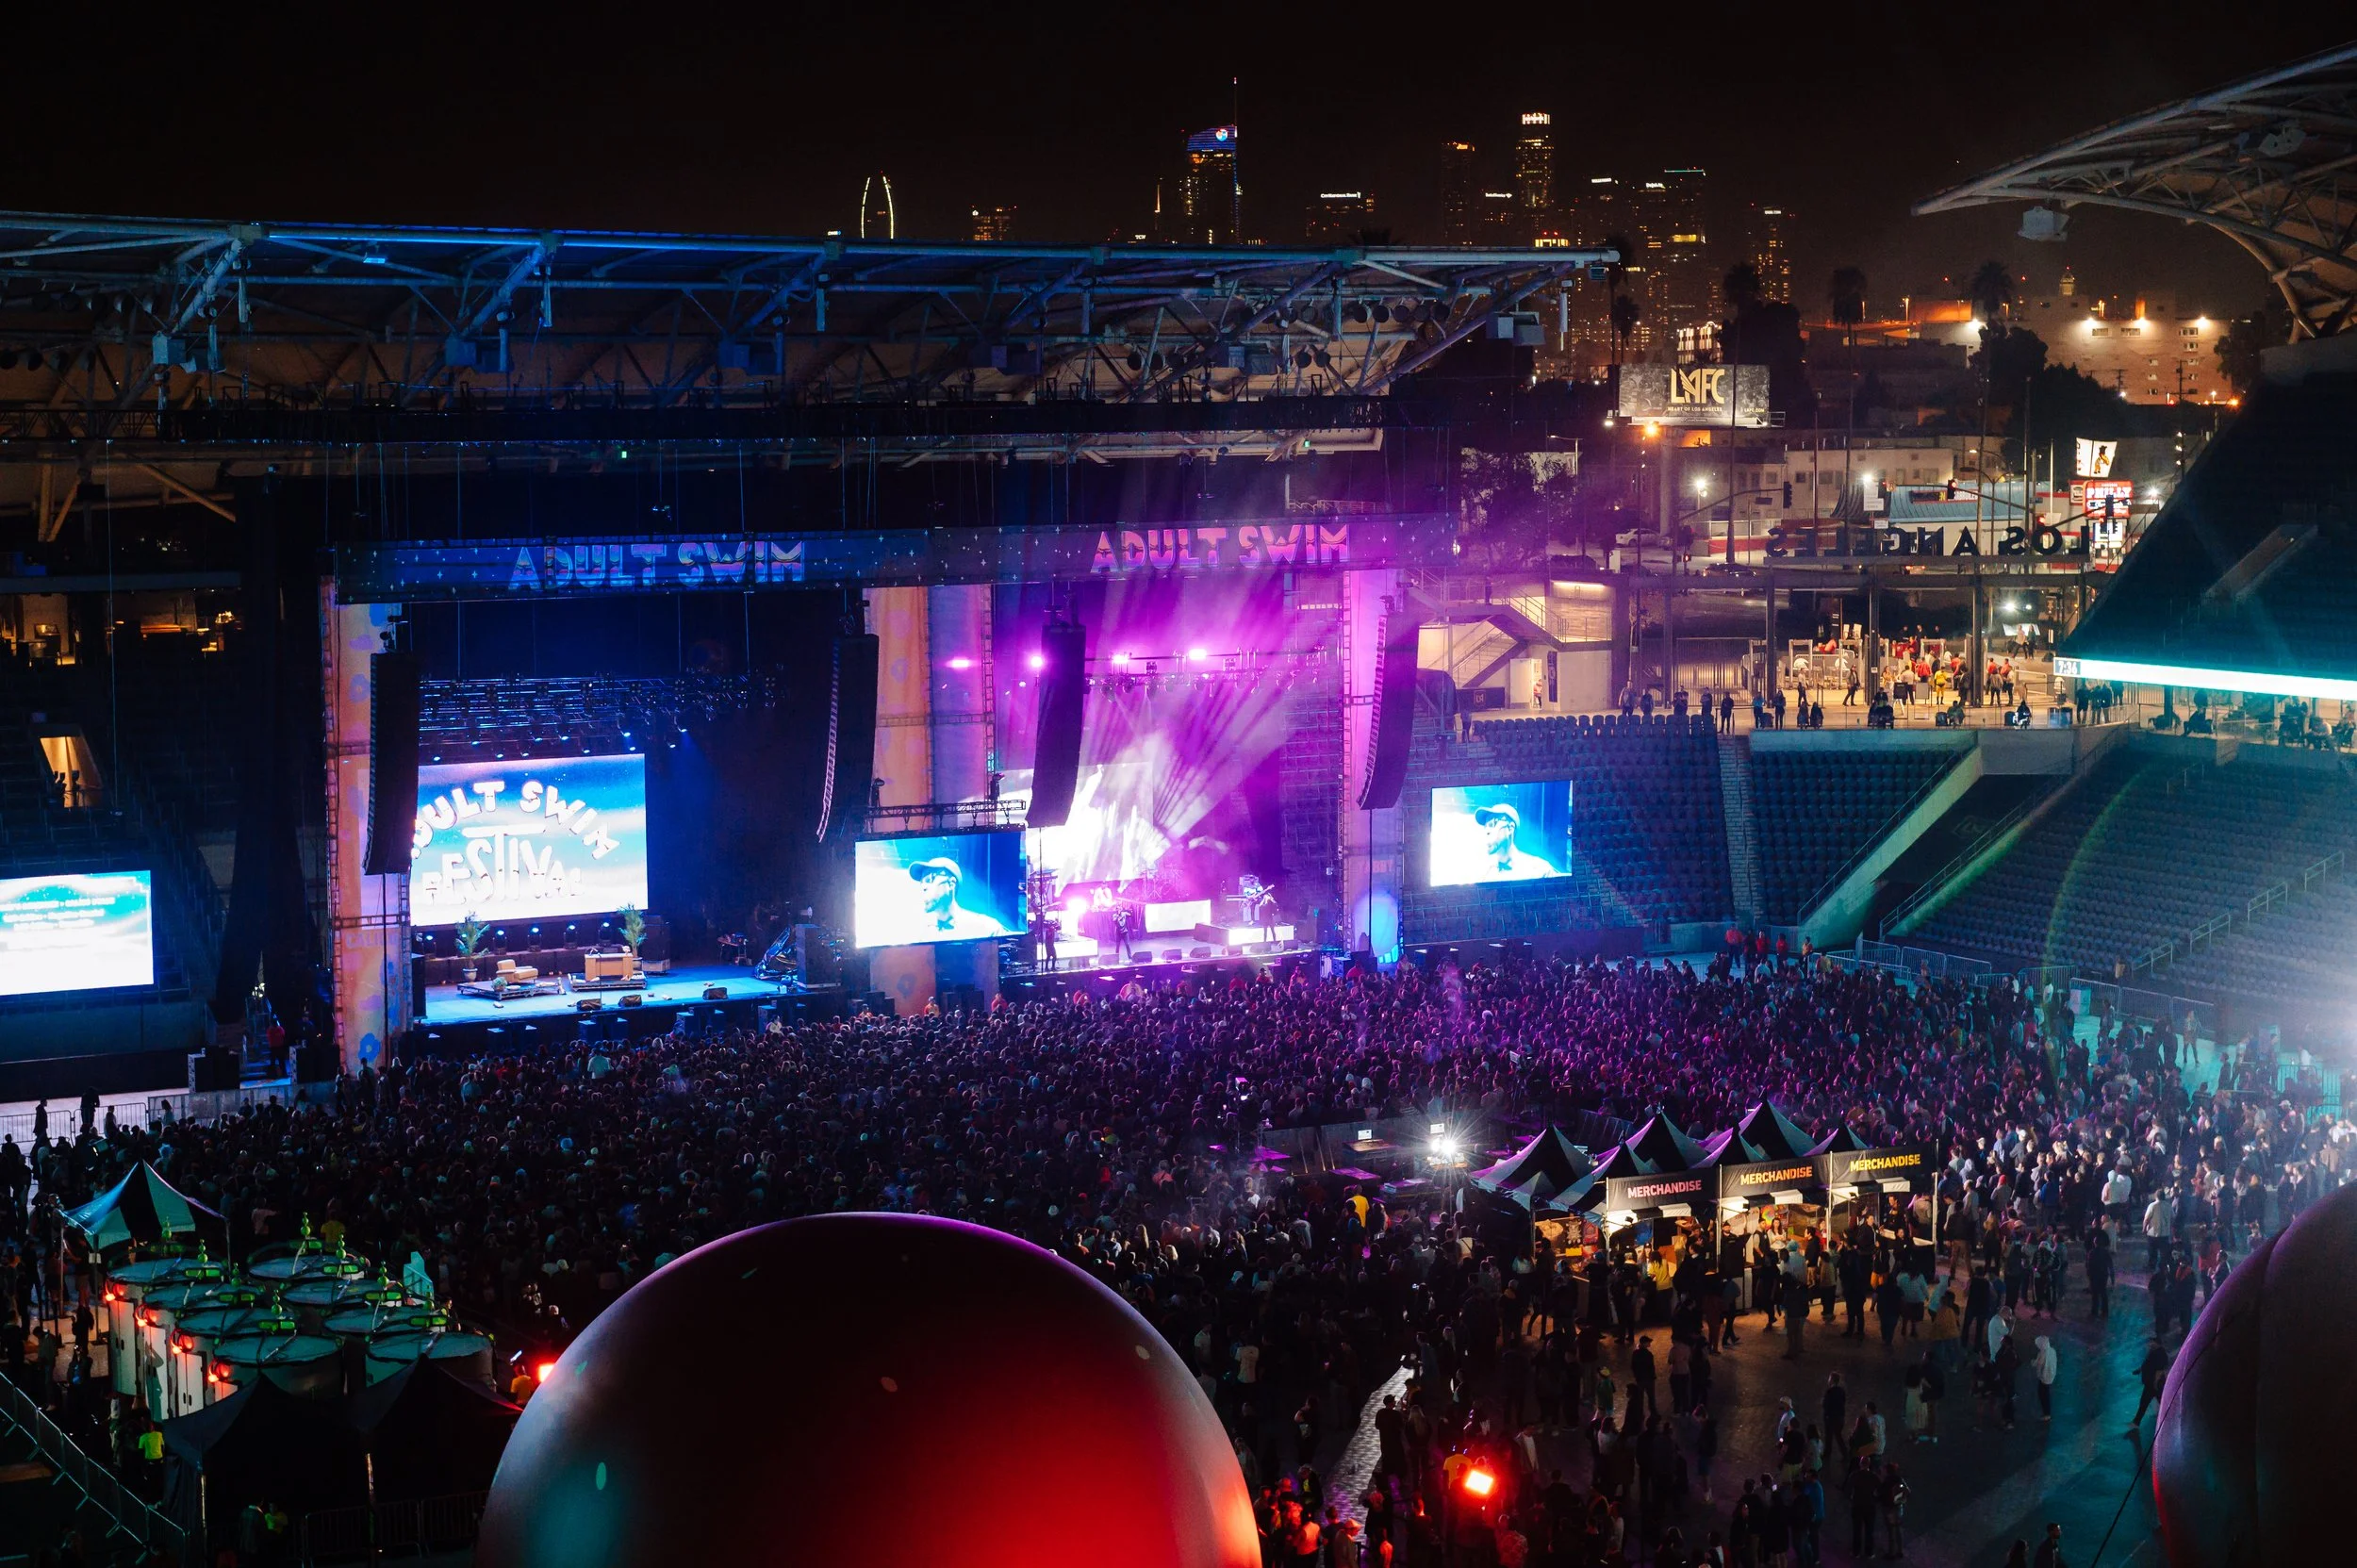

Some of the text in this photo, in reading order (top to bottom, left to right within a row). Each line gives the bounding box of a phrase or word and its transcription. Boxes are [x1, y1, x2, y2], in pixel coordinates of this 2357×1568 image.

[1671, 367, 1725, 404] LAFC
[507, 540, 805, 591] ADULT SWIM
[1090, 524, 1350, 573] ADULT SWIM
[411, 781, 620, 860] DULT SWIM
[422, 823, 585, 905] FESTIVAL
[1740, 1165, 1813, 1186] MERCHANDISE
[1850, 1154, 1920, 1172] MERCHANDISE
[1627, 1180, 1702, 1199] MERCHANDISE
